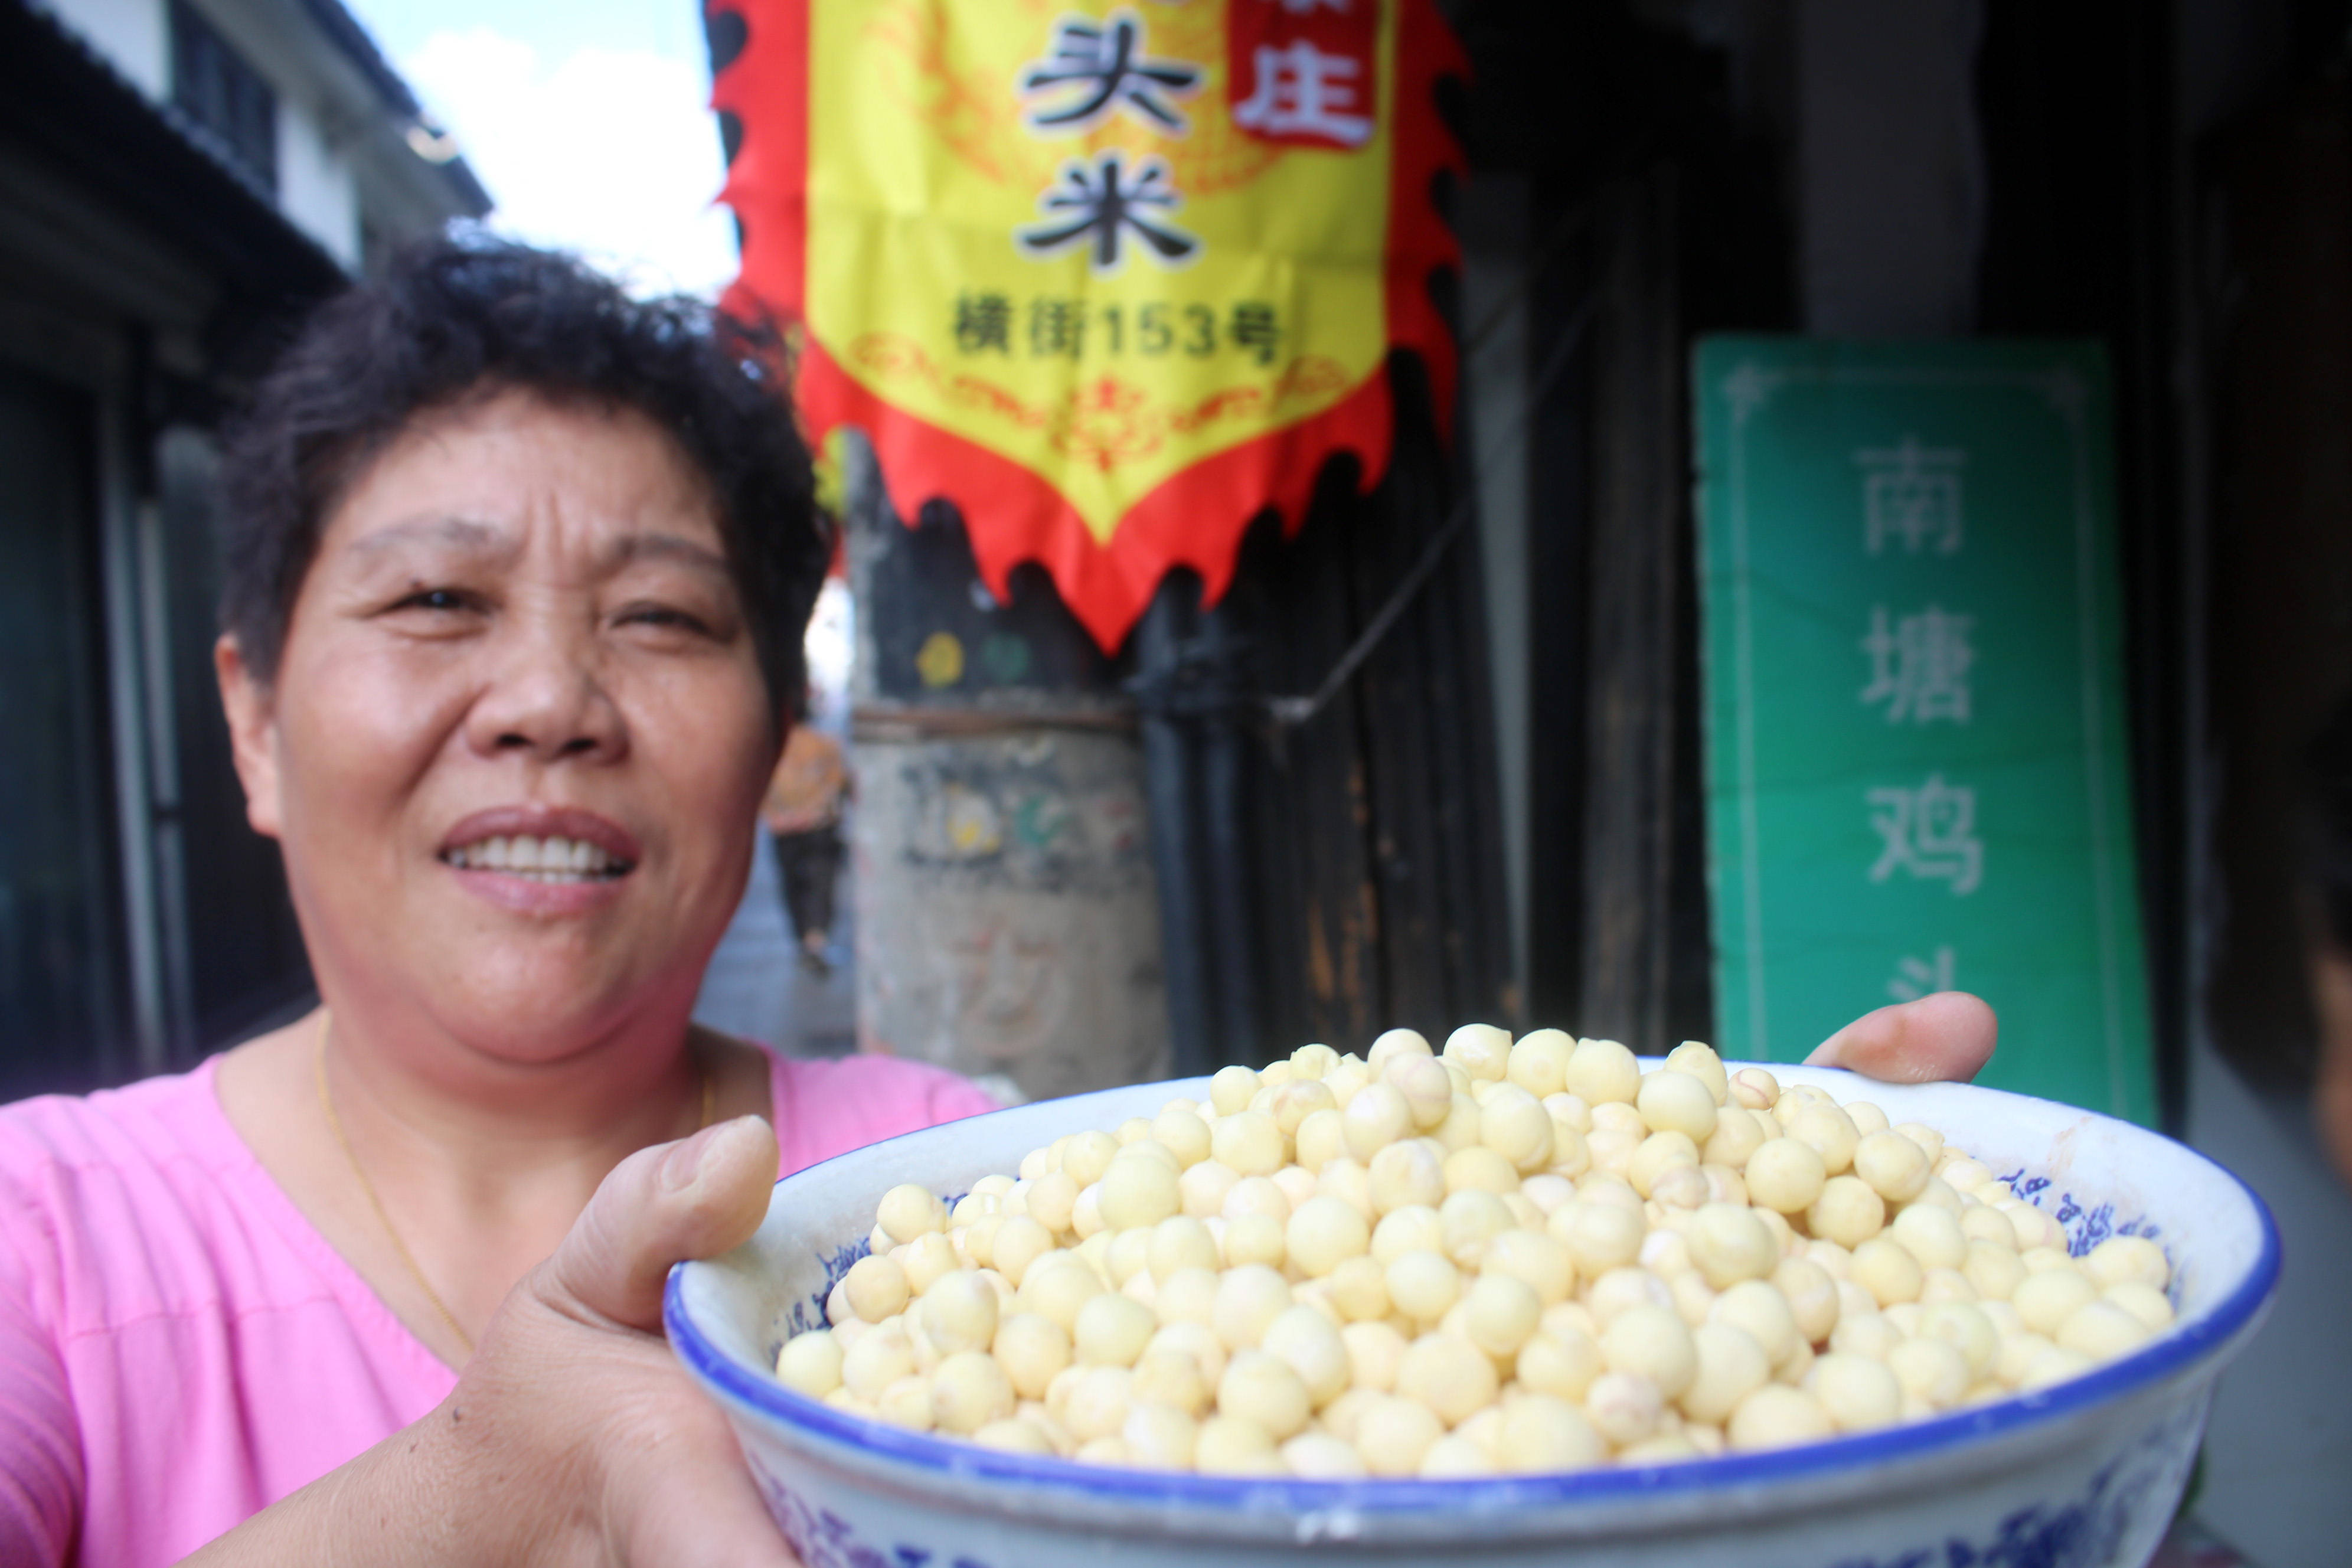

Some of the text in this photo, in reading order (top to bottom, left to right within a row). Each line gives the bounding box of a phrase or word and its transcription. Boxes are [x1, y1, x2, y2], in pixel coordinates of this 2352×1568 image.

[1233, 0, 1373, 146] 庄
[953, 289, 1281, 366] 横街153号
